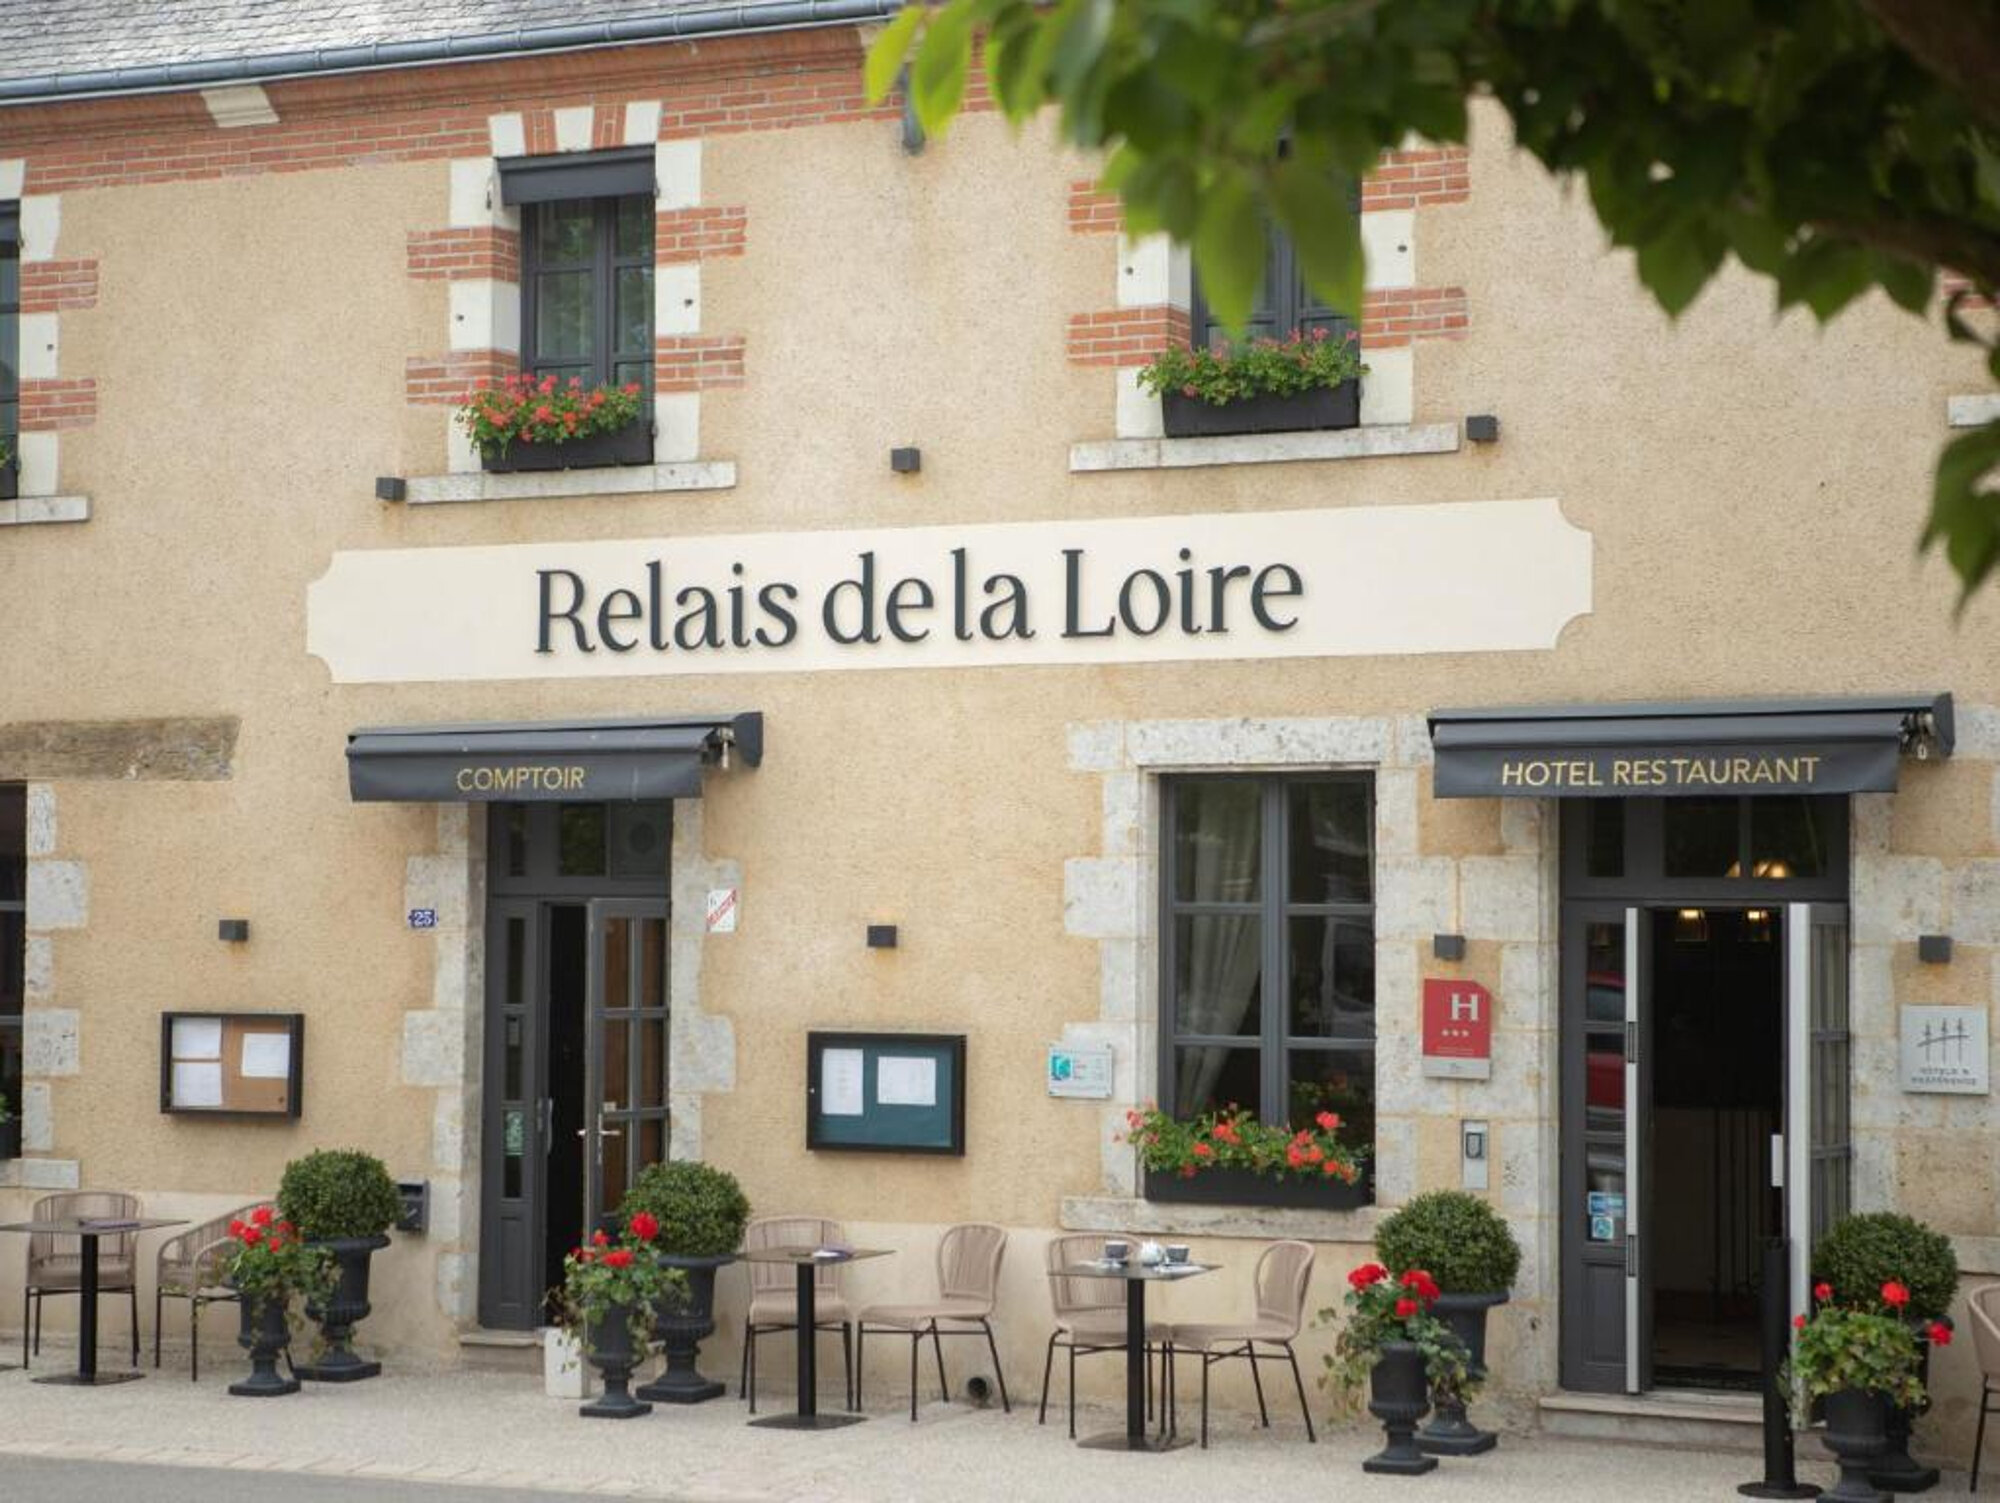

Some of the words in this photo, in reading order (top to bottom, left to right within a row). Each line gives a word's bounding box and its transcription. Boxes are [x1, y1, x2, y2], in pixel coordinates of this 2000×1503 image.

[534, 559, 798, 655] Relais
[822, 551, 935, 645] de
[950, 547, 1036, 642] la
[1060, 547, 1304, 639] Loire
[456, 765, 586, 792] COMPTOIR
[1501, 761, 1603, 787] HOTEL
[1612, 756, 1820, 785] RESTAURANT
[414, 911, 432, 927] 25
[1451, 993, 1479, 1021] H
